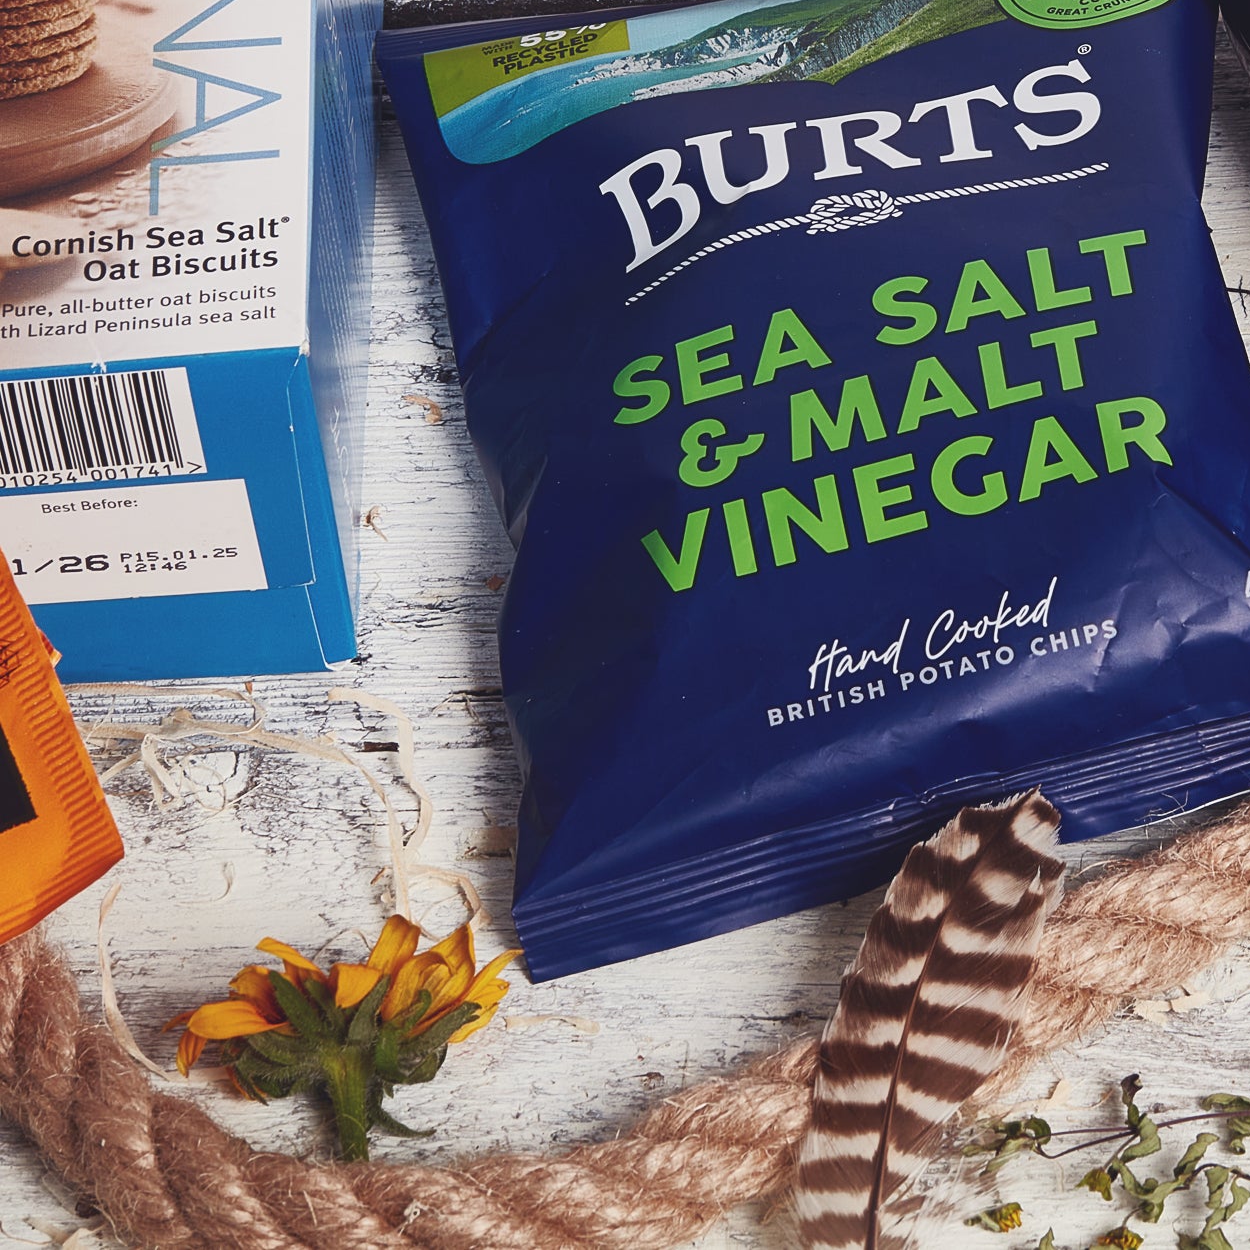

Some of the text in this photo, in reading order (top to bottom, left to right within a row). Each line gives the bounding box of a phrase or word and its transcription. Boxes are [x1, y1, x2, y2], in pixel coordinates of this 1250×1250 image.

[1047, 7, 1089, 15] GREAT
[493, 33, 597, 67] RECYCLED
[504, 44, 589, 74] PLASTIC
[12, 227, 204, 258] Cornish Sea
[83, 249, 278, 281] Oat Biscuits
[2, 286, 276, 317] Pure, all-butter oat biscuits
[28, 306, 276, 337] Lizard Peninsula sea salt
[613, 230, 1147, 426] SEA SALT
[678, 320, 1097, 488] & MALT
[41, 499, 138, 514] Best Before:
[641, 396, 1173, 593] VINEGAR
[120, 547, 238, 562] P15.01.25
[124, 561, 187, 573] 12:46
[807, 576, 1058, 690] Hand Cooked
[767, 619, 1118, 727] BRITISH POTATO CHIPS
